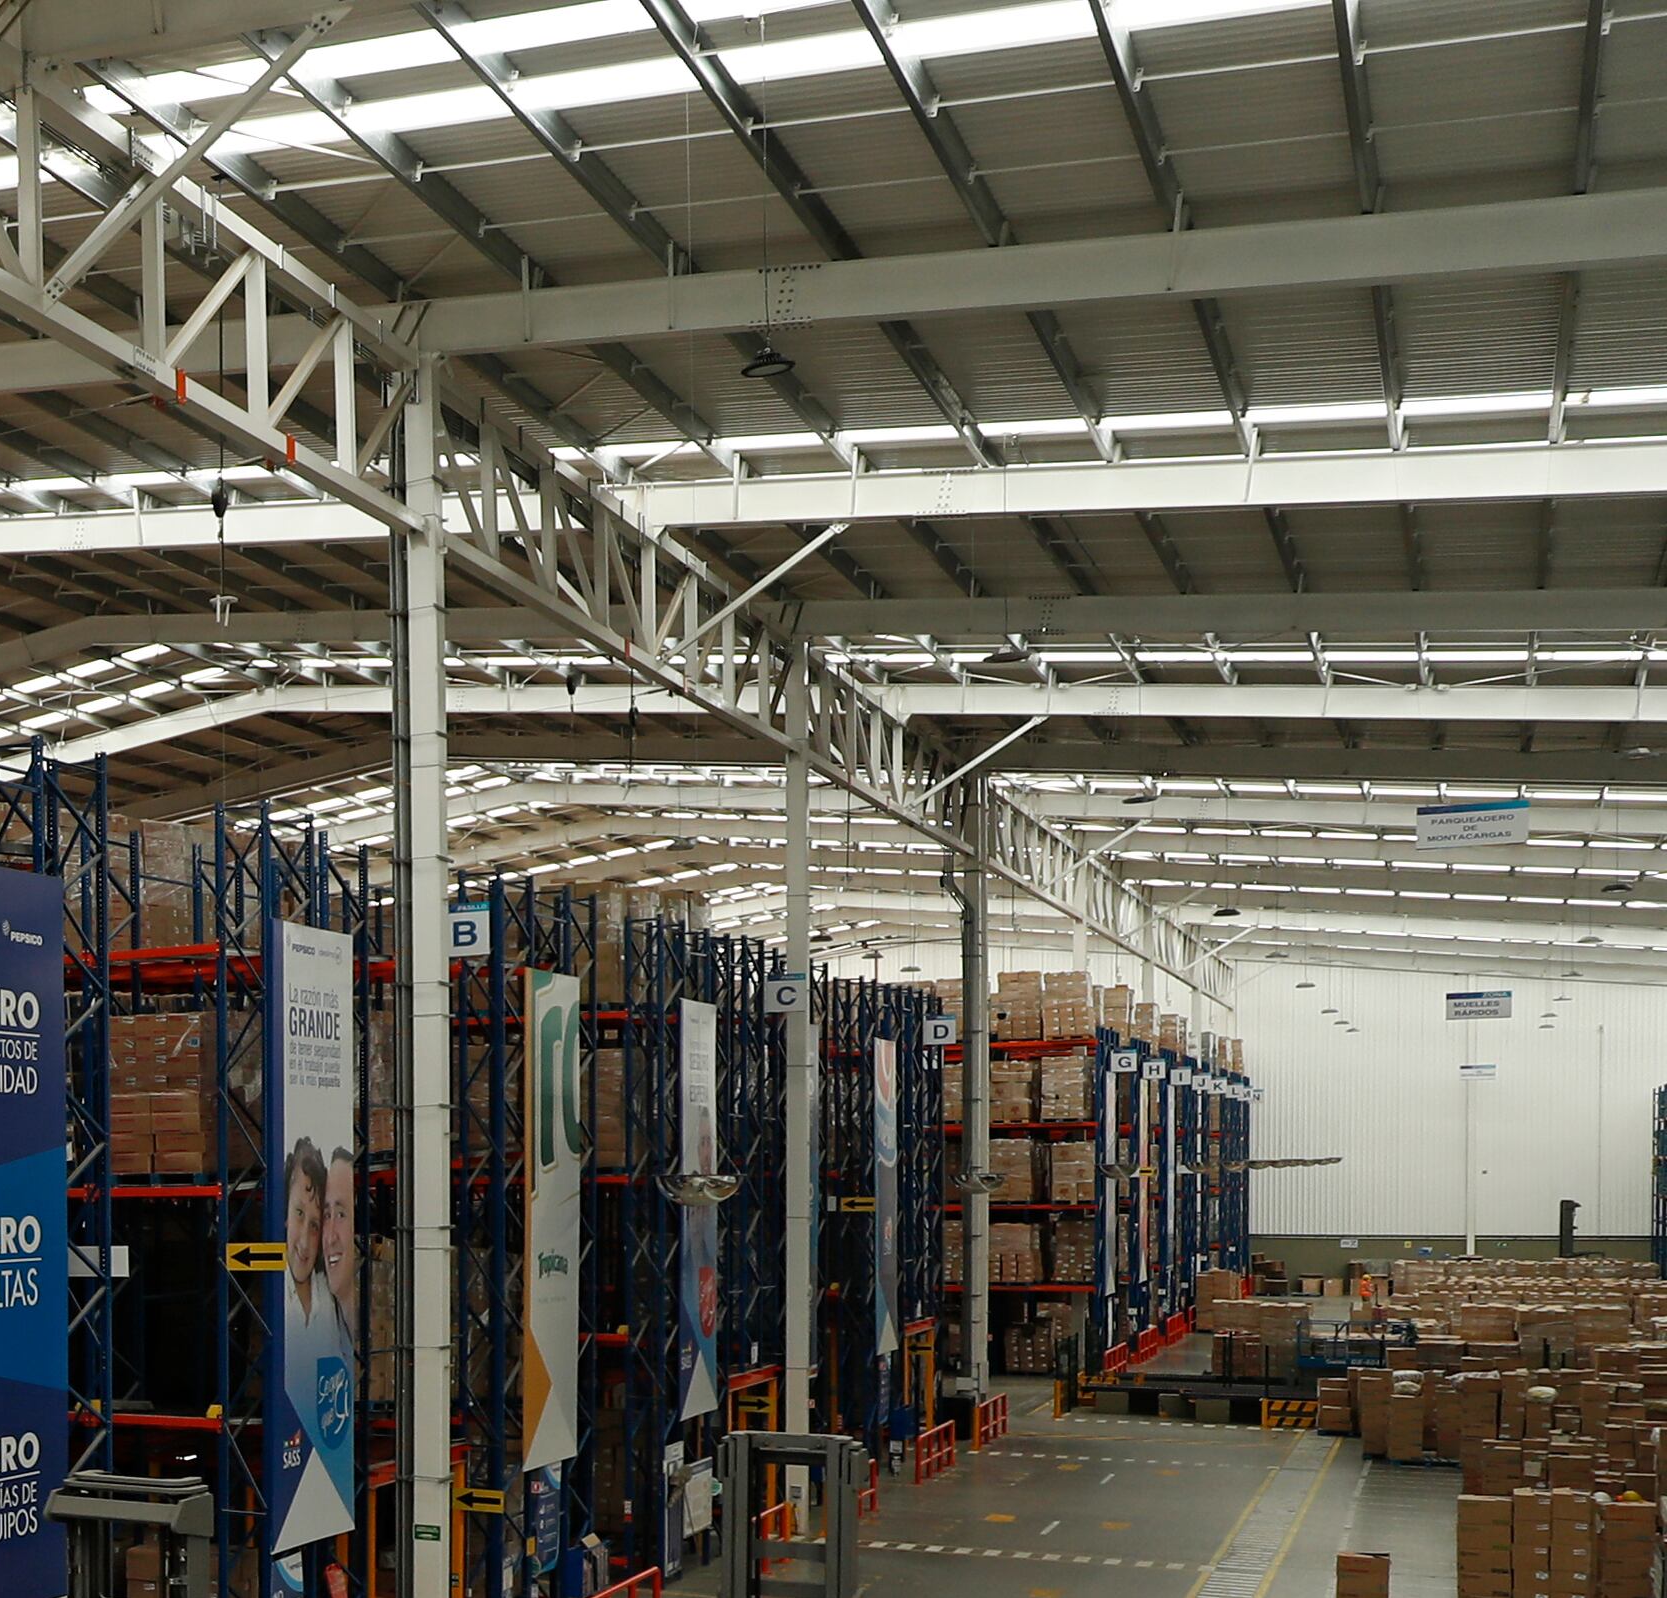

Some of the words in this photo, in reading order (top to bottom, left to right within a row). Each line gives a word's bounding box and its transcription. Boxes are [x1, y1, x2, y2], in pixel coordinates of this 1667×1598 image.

[1431, 814, 1515, 825] PARQUEADERO
[1427, 831, 1512, 841] MONTACARGAS
[10, 931, 43, 946] PEPSICO
[453, 920, 478, 947] B
[292, 943, 315, 955] PEPSICO
[289, 982, 299, 1004] La
[300, 986, 321, 1007] razón
[323, 989, 339, 1010] más
[777, 986, 797, 1005] C
[289, 1006, 340, 1041] GRANDE
[933, 1025, 949, 1039] D
[24, 1041, 38, 1061] DE
[289, 1040, 297, 1054] de
[314, 1043, 341, 1061] seguridad
[1118, 1056, 1132, 1068] G
[1148, 1065, 1160, 1075] H
[1198, 1078, 1206, 1087] J
[1213, 1081, 1223, 1091] K
[1232, 1087, 1238, 1095] L
[282, 1448, 301, 1470] SASS
[22, 1481, 38, 1504] DE
